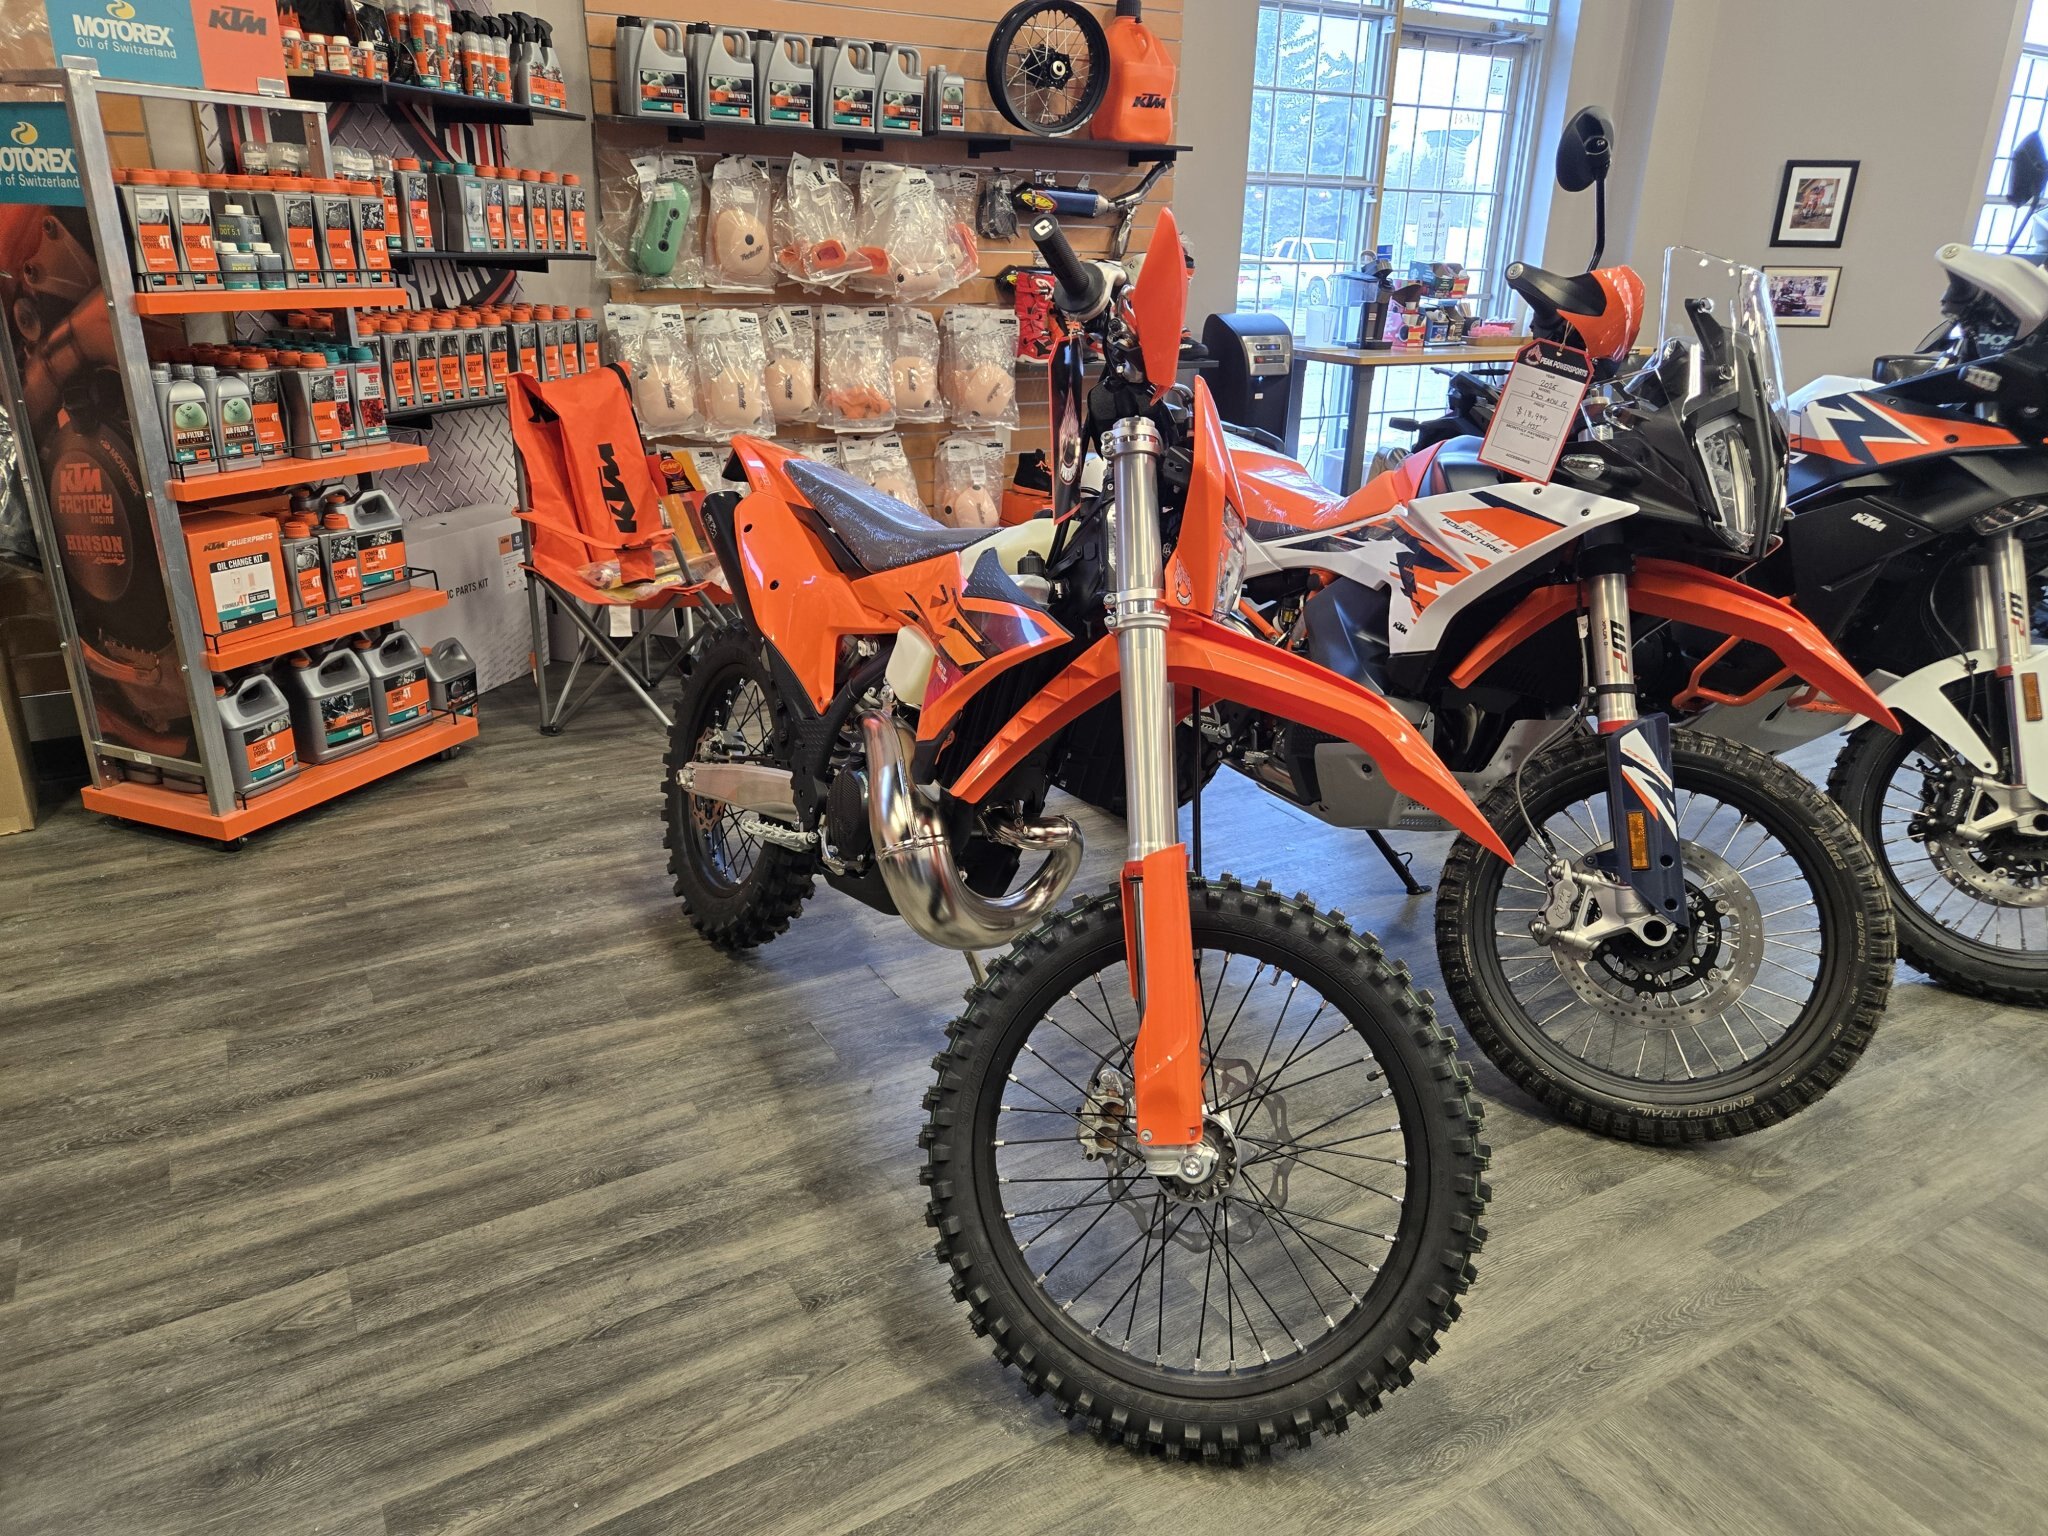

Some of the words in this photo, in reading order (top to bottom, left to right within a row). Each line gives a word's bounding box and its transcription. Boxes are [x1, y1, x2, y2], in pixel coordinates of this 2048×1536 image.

[208, 5, 267, 36] KTM
[72, 14, 174, 47] MOTOREX
[77, 37, 93, 48] Oil
[97, 40, 109, 50] of
[113, 42, 177, 59] Switzerland
[1132, 93, 1165, 109] KTM
[5, 174, 15, 186] of
[18, 174, 80, 188] Switzerland
[159, 235, 169, 249] 4T
[201, 235, 210, 249] 4T
[1540, 357, 1553, 367] PEAK
[1553, 360, 1588, 377] POWERSPORTS
[1540, 380, 1559, 391] 2025
[177, 432, 187, 440] AIR
[187, 431, 204, 439] FILTER
[234, 425, 249, 433] FILTER
[60, 463, 103, 493] KTM
[109, 447, 142, 497] MOTOREX
[597, 443, 637, 533] KTM
[58, 493, 114, 514] FACTORY
[90, 515, 115, 525] RACING
[1851, 512, 1886, 532] KTM
[65, 535, 124, 552] HINSON
[203, 541, 225, 552] KTM
[227, 532, 273, 547] POWERPARTS
[1442, 518, 1503, 554] ADVENTURE
[217, 561, 228, 571] OIL
[228, 556, 254, 569] CHANGE
[254, 554, 263, 564] KIT
[377, 548, 387, 560] 4T
[346, 566, 357, 578] 4T
[311, 575, 321, 588] 4T
[456, 584, 477, 597] PARTS
[478, 578, 489, 589] KIT
[237, 593, 248, 606] 4T
[2009, 591, 2025, 637] WP
[1393, 621, 1408, 635] KTM
[1610, 619, 1629, 673] WP
[402, 687, 411, 699] 4T
[266, 738, 276, 752] 4T
[1947, 788, 1964, 816] brembo
[1809, 825, 1847, 871] Mitas
[1687, 1096, 1756, 1119] ENDURO
